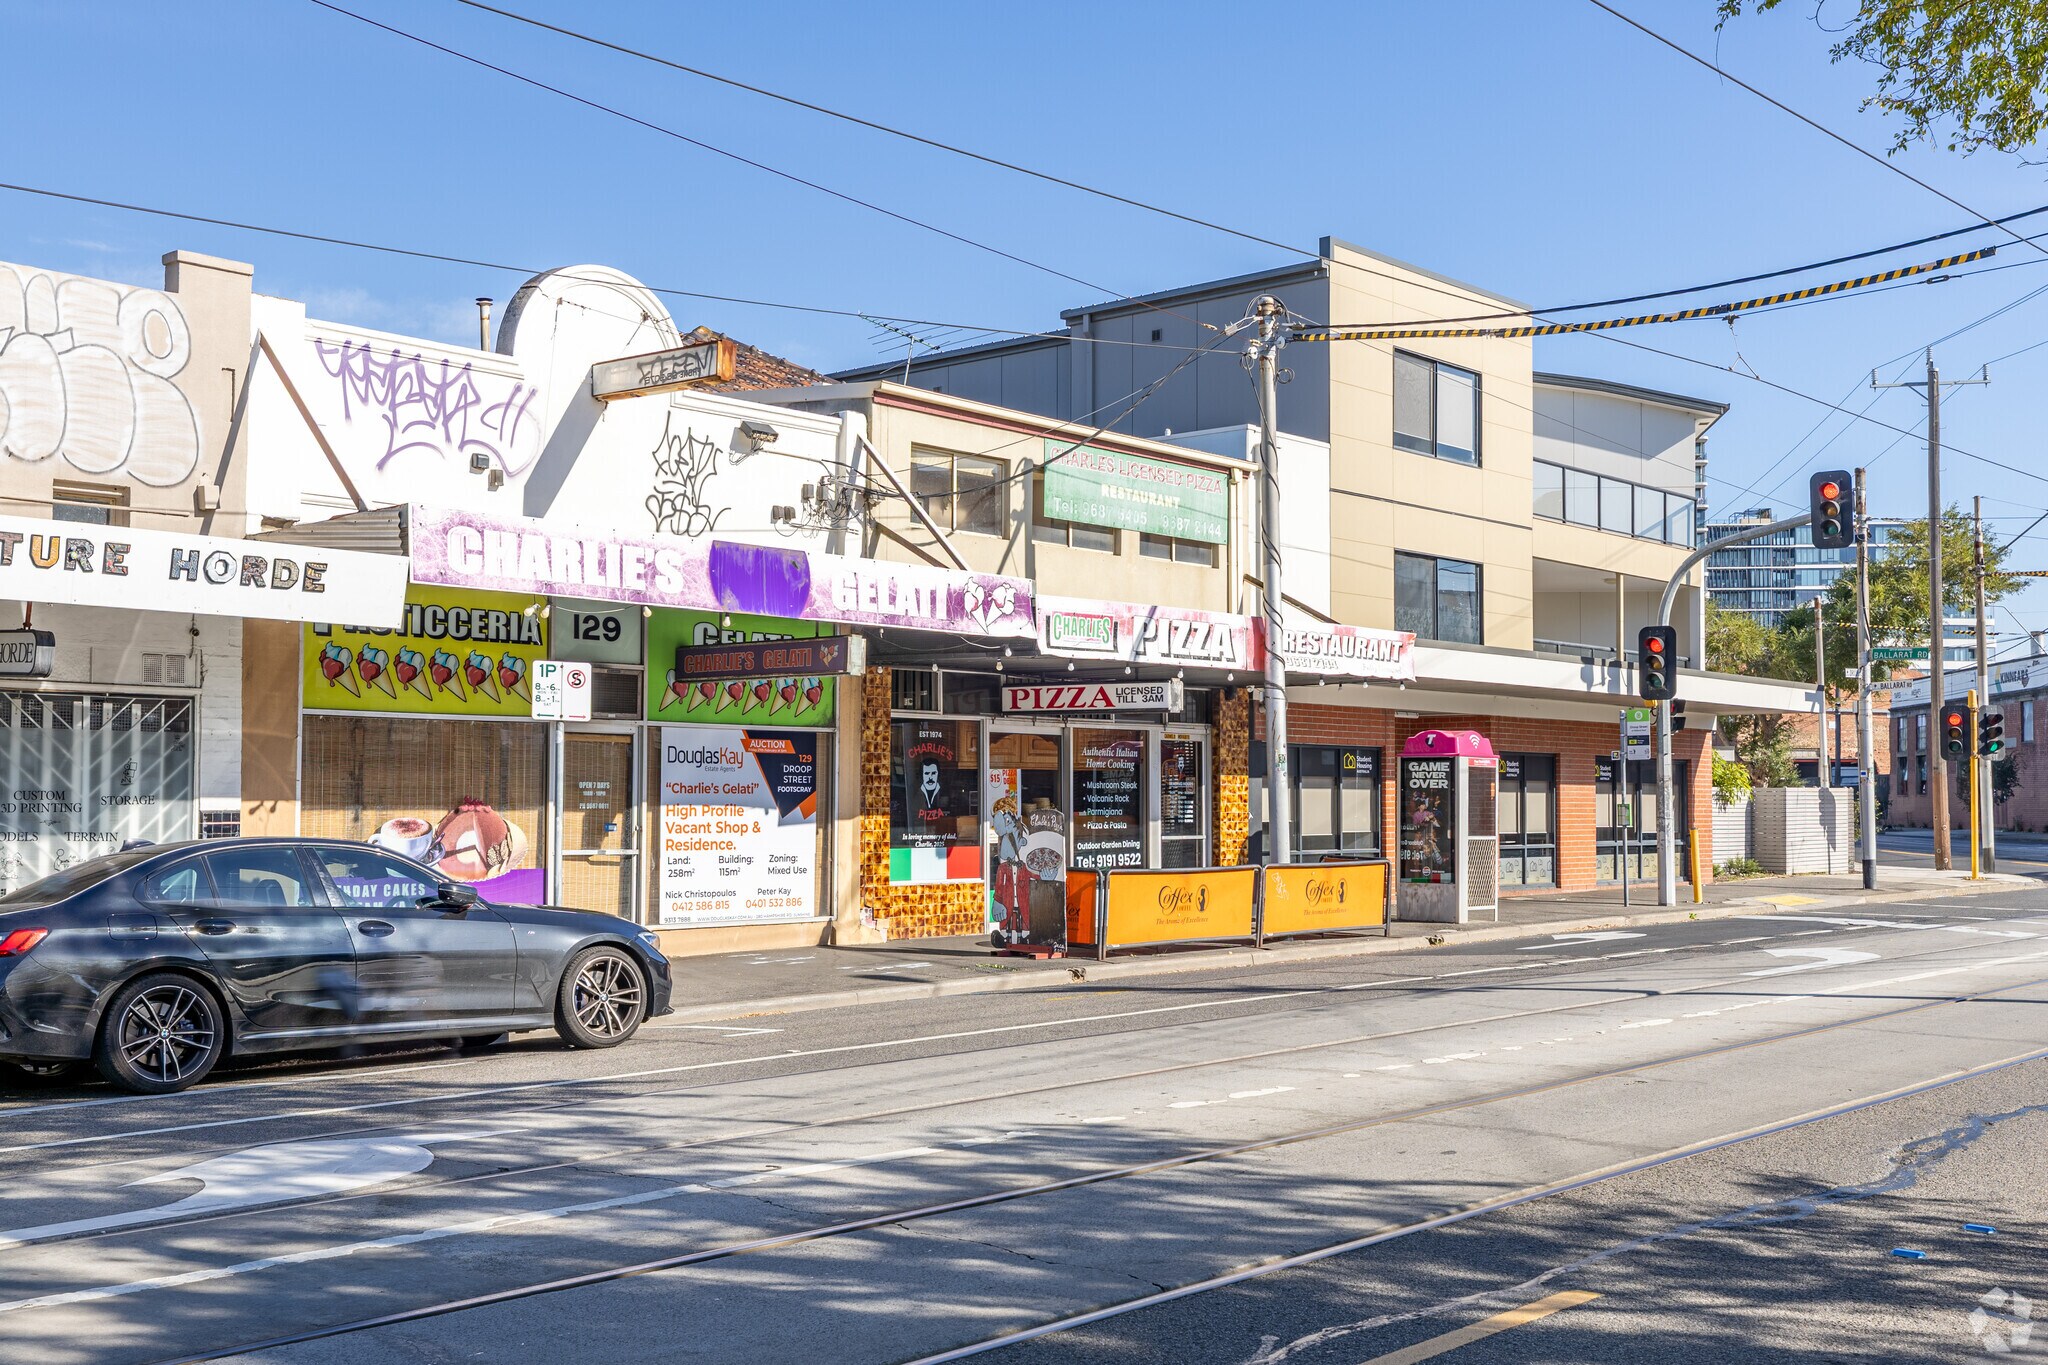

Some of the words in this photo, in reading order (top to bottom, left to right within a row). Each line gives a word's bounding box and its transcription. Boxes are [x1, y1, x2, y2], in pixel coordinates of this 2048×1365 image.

[1050, 447, 1116, 475] CHARLES
[1118, 458, 1184, 487] LICENSED
[1186, 473, 1222, 494] PIZZA
[1101, 483, 1181, 509] RESTAURANT
[1054, 497, 1078, 514] Tel:
[169, 547, 328, 593] HORDE
[448, 525, 684, 595] CHARLIE'S
[831, 571, 950, 619] GELATI
[313, 602, 543, 645] TICCERIA
[573, 614, 621, 642] 129
[1052, 614, 1111, 644] CHARLIES
[1131, 616, 1237, 662] PIZZA
[1283, 629, 1403, 663] RESTAURANT
[684, 651, 755, 674] CHARLIE'S
[763, 648, 812, 669] GELATI
[1874, 651, 1913, 659] BALLARAT
[539, 664, 556, 677] 1P
[1115, 686, 1164, 695] LICENSED
[1880, 681, 1907, 690] BALLARAT
[1008, 685, 1116, 710] PIZZA
[1116, 695, 1137, 703] TILL
[1142, 695, 1164, 703] 3AM
[750, 740, 785, 748] AUCTION
[667, 746, 744, 769] DouglasKay
[908, 743, 954, 761] CHARLIE'S
[1082, 747, 1114, 757] Authentic
[1115, 747, 1138, 758] Italian
[720, 765, 736, 773] Agents
[783, 765, 812, 773] DROOP
[1086, 759, 1107, 769] Home
[1107, 759, 1135, 771] Cooking
[1409, 762, 1450, 772] GAME
[783, 775, 812, 783] STREET
[990, 774, 1001, 782] $15
[1409, 779, 1448, 789] OVER
[1087, 781, 1119, 789] Mushroom
[1120, 781, 1137, 789] Steak
[13, 790, 65, 801] CUSTOM
[100, 796, 155, 806] STORAGE
[1087, 794, 1114, 802] Volcanic
[1115, 794, 1129, 802] Rock
[1, 803, 17, 813] 3D
[20, 802, 82, 813] PRINTING
[666, 804, 697, 819] High
[701, 804, 745, 817] Profile
[1087, 808, 1122, 818] Parmigiana
[918, 808, 944, 820] PIZZA
[666, 821, 712, 834] Vacant
[715, 821, 748, 836] Shop
[752, 822, 761, 833] &
[64, 832, 118, 842] TERRAIN
[908, 833, 923, 841] loving
[666, 838, 736, 851] Residence.
[1077, 842, 1101, 850] Outdoor
[1101, 841, 1122, 849] Garden
[1122, 840, 1140, 849] Dining
[667, 856, 691, 865] Land:
[718, 855, 754, 865] Building:
[769, 854, 798, 864] Zoning:
[1077, 855, 1095, 868] Tel:
[1096, 854, 1116, 867] 9191
[1118, 853, 1141, 866] 9522
[767, 866, 791, 875] Mixed
[793, 866, 807, 874] Use
[336, 884, 377, 898] HDAY
[383, 883, 425, 897] CAKES
[665, 890, 682, 899] Nick
[684, 888, 736, 898] Christopoulos
[757, 887, 776, 896] Peter
[778, 887, 791, 897] Kay
[672, 902, 694, 911] 0412
[696, 901, 714, 911] 586
[715, 901, 730, 910] 815
[745, 899, 767, 908] 0401
[768, 899, 784, 908] 532
[785, 898, 802, 907] 886
[1158, 885, 1193, 916] Coffex
[1181, 917, 1186, 925] of
